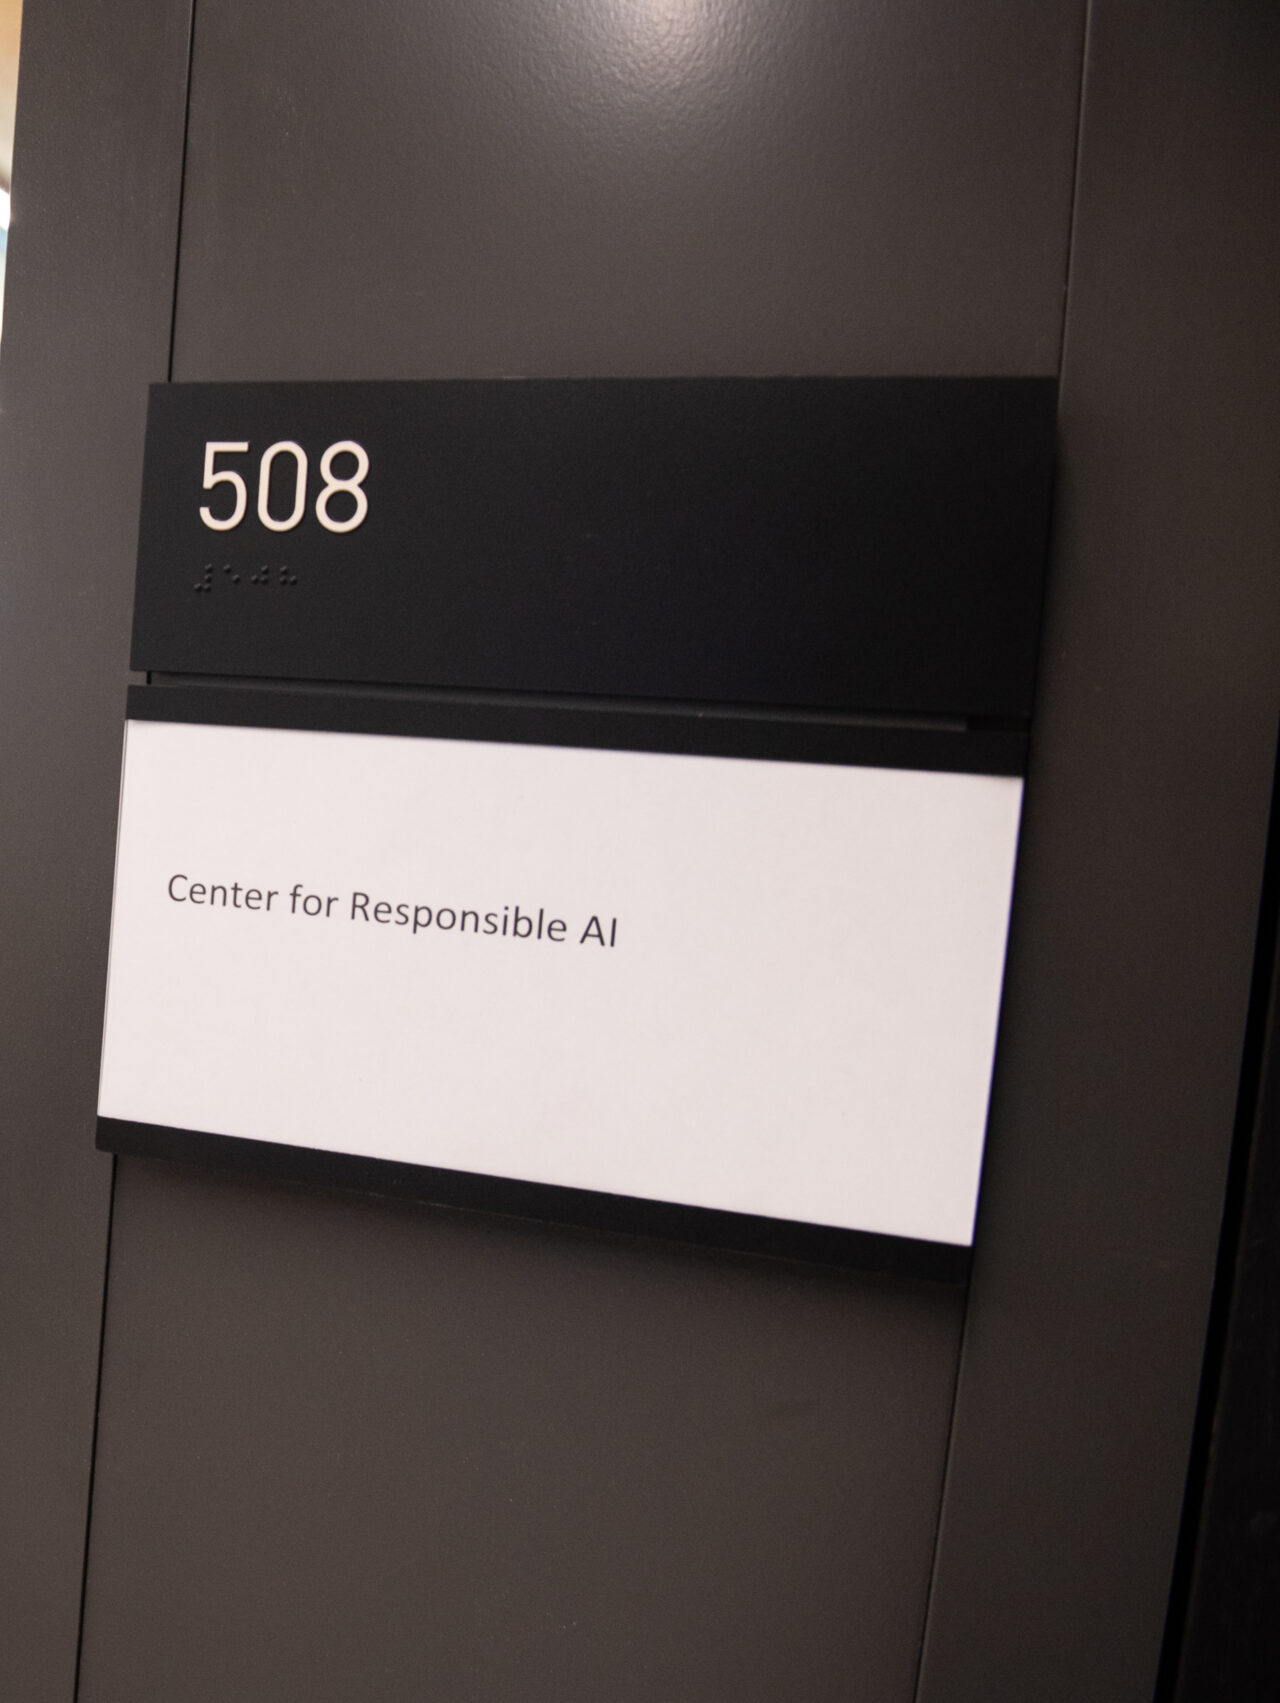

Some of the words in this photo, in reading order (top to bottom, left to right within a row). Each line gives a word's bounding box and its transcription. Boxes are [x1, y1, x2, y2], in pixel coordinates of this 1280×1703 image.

[199, 440, 371, 533] 508
[168, 873, 280, 911] Center
[289, 884, 340, 918] for
[350, 892, 568, 943] Responsible
[579, 915, 618, 948] AI
